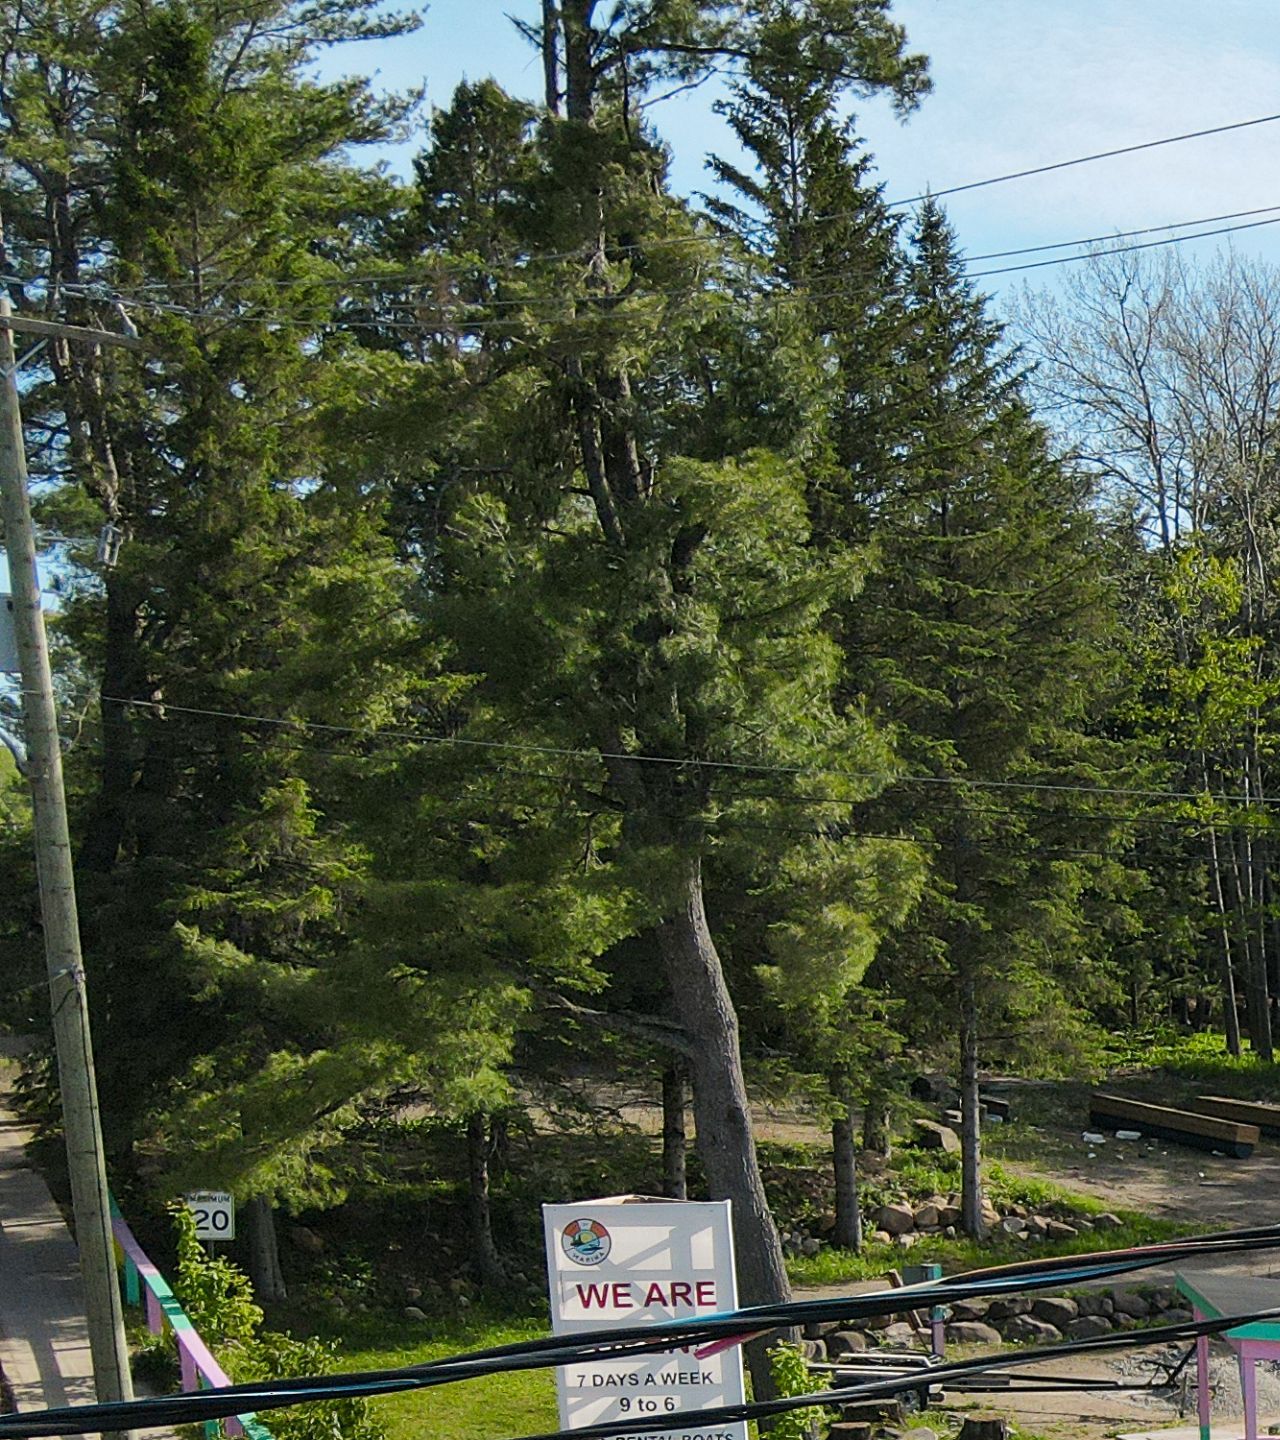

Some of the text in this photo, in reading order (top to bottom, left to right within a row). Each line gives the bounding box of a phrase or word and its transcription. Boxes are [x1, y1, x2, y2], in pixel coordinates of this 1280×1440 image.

[194, 1209, 229, 1231] 20
[576, 1281, 717, 1309] WE ARE
[577, 1370, 714, 1388] 7 DAYS A WEEK
[619, 1396, 675, 1412] 9 to 6
